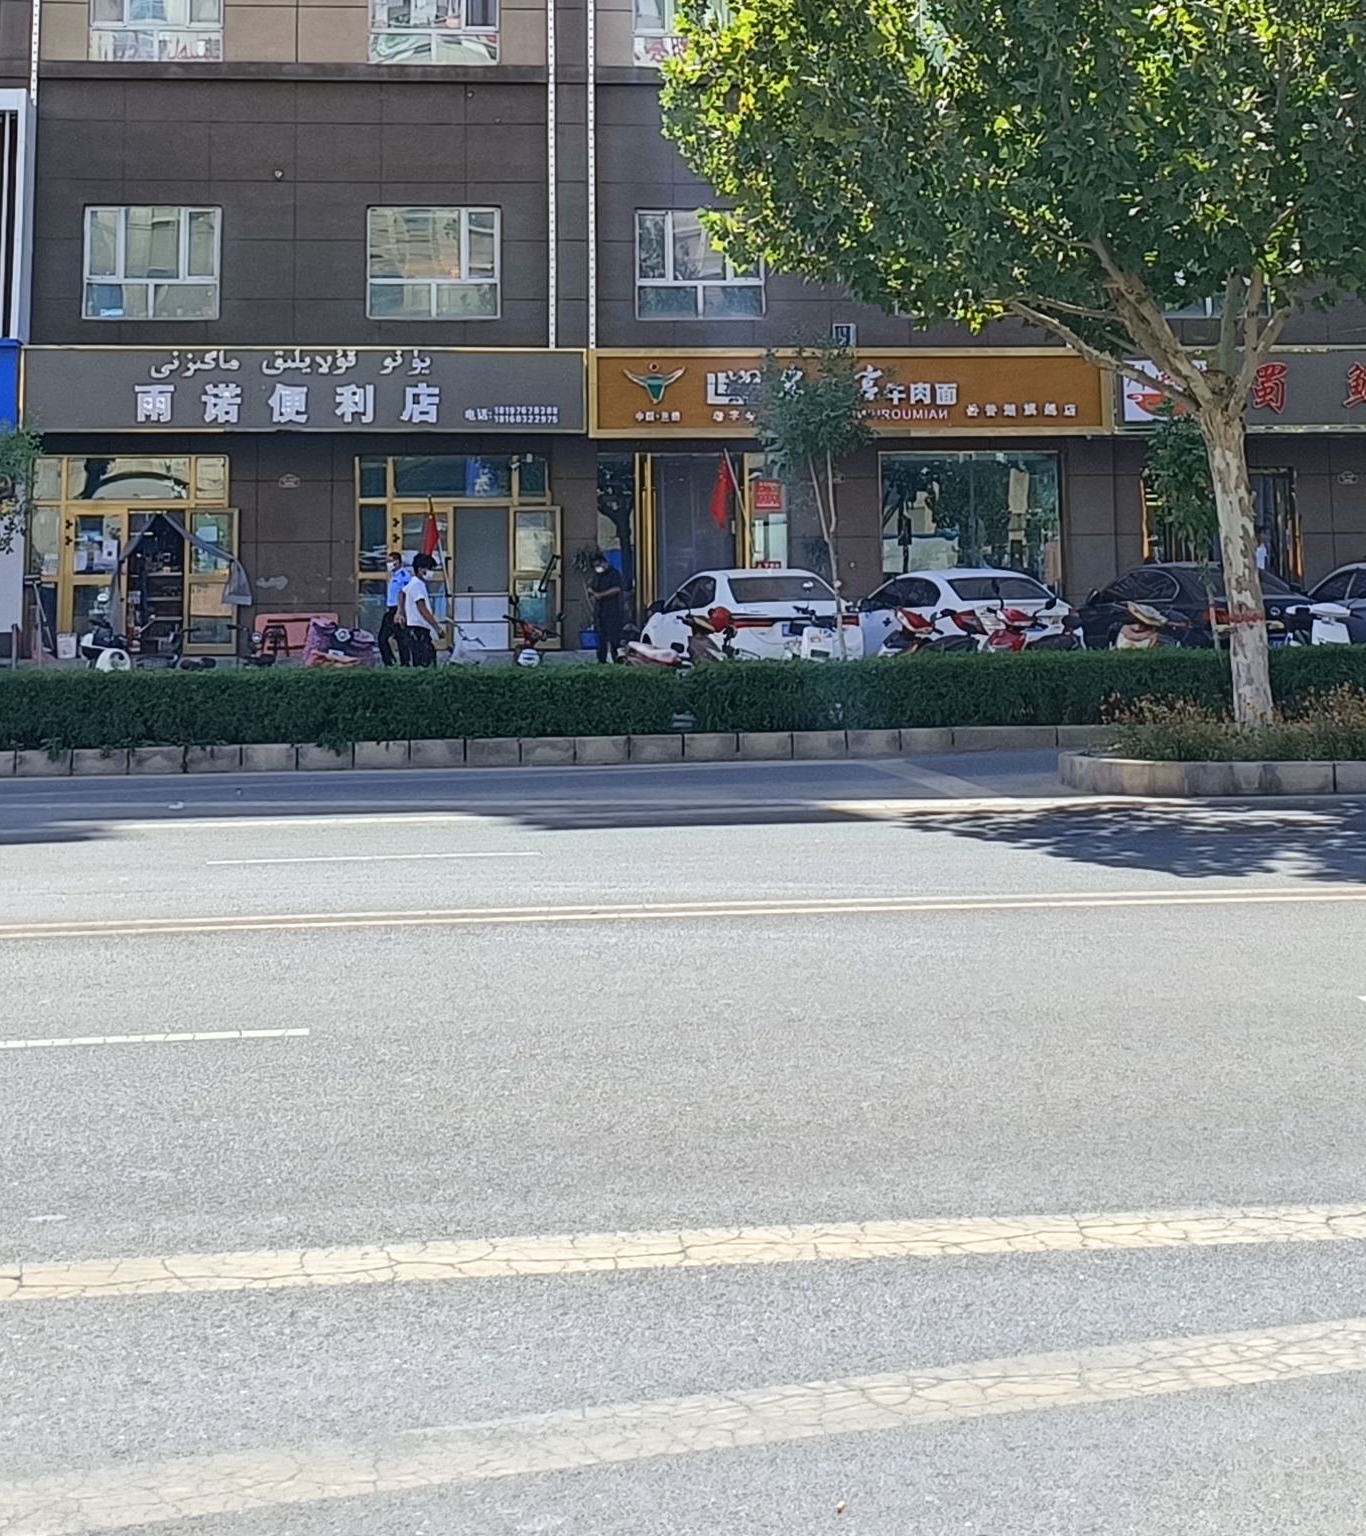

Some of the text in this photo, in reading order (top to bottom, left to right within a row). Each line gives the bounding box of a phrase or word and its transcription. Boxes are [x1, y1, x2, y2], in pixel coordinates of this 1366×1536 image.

[134, 382, 441, 424] 雨诺便利店
